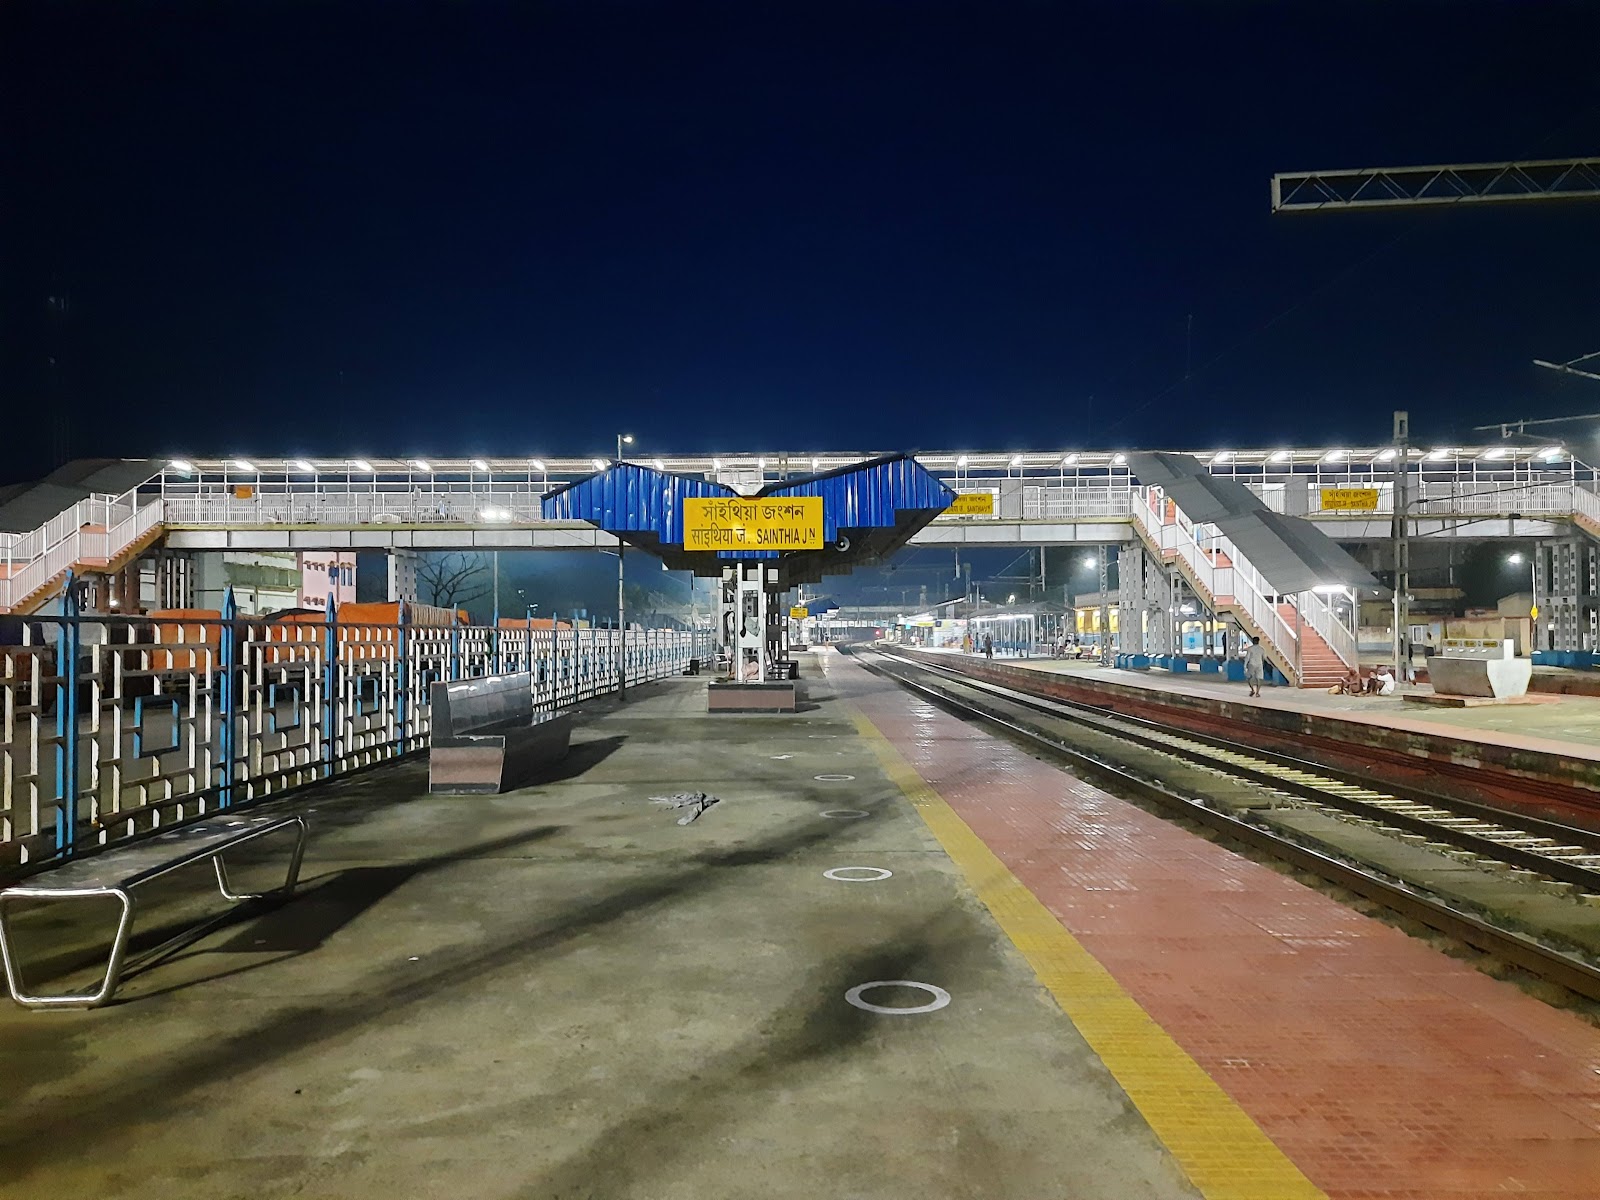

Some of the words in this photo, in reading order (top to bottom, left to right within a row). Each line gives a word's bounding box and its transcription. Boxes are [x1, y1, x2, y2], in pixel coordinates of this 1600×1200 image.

[702, 499, 758, 521] সাঁইথিয়া
[761, 504, 805, 520] জংশন
[757, 528, 799, 544] SAINTHIA
